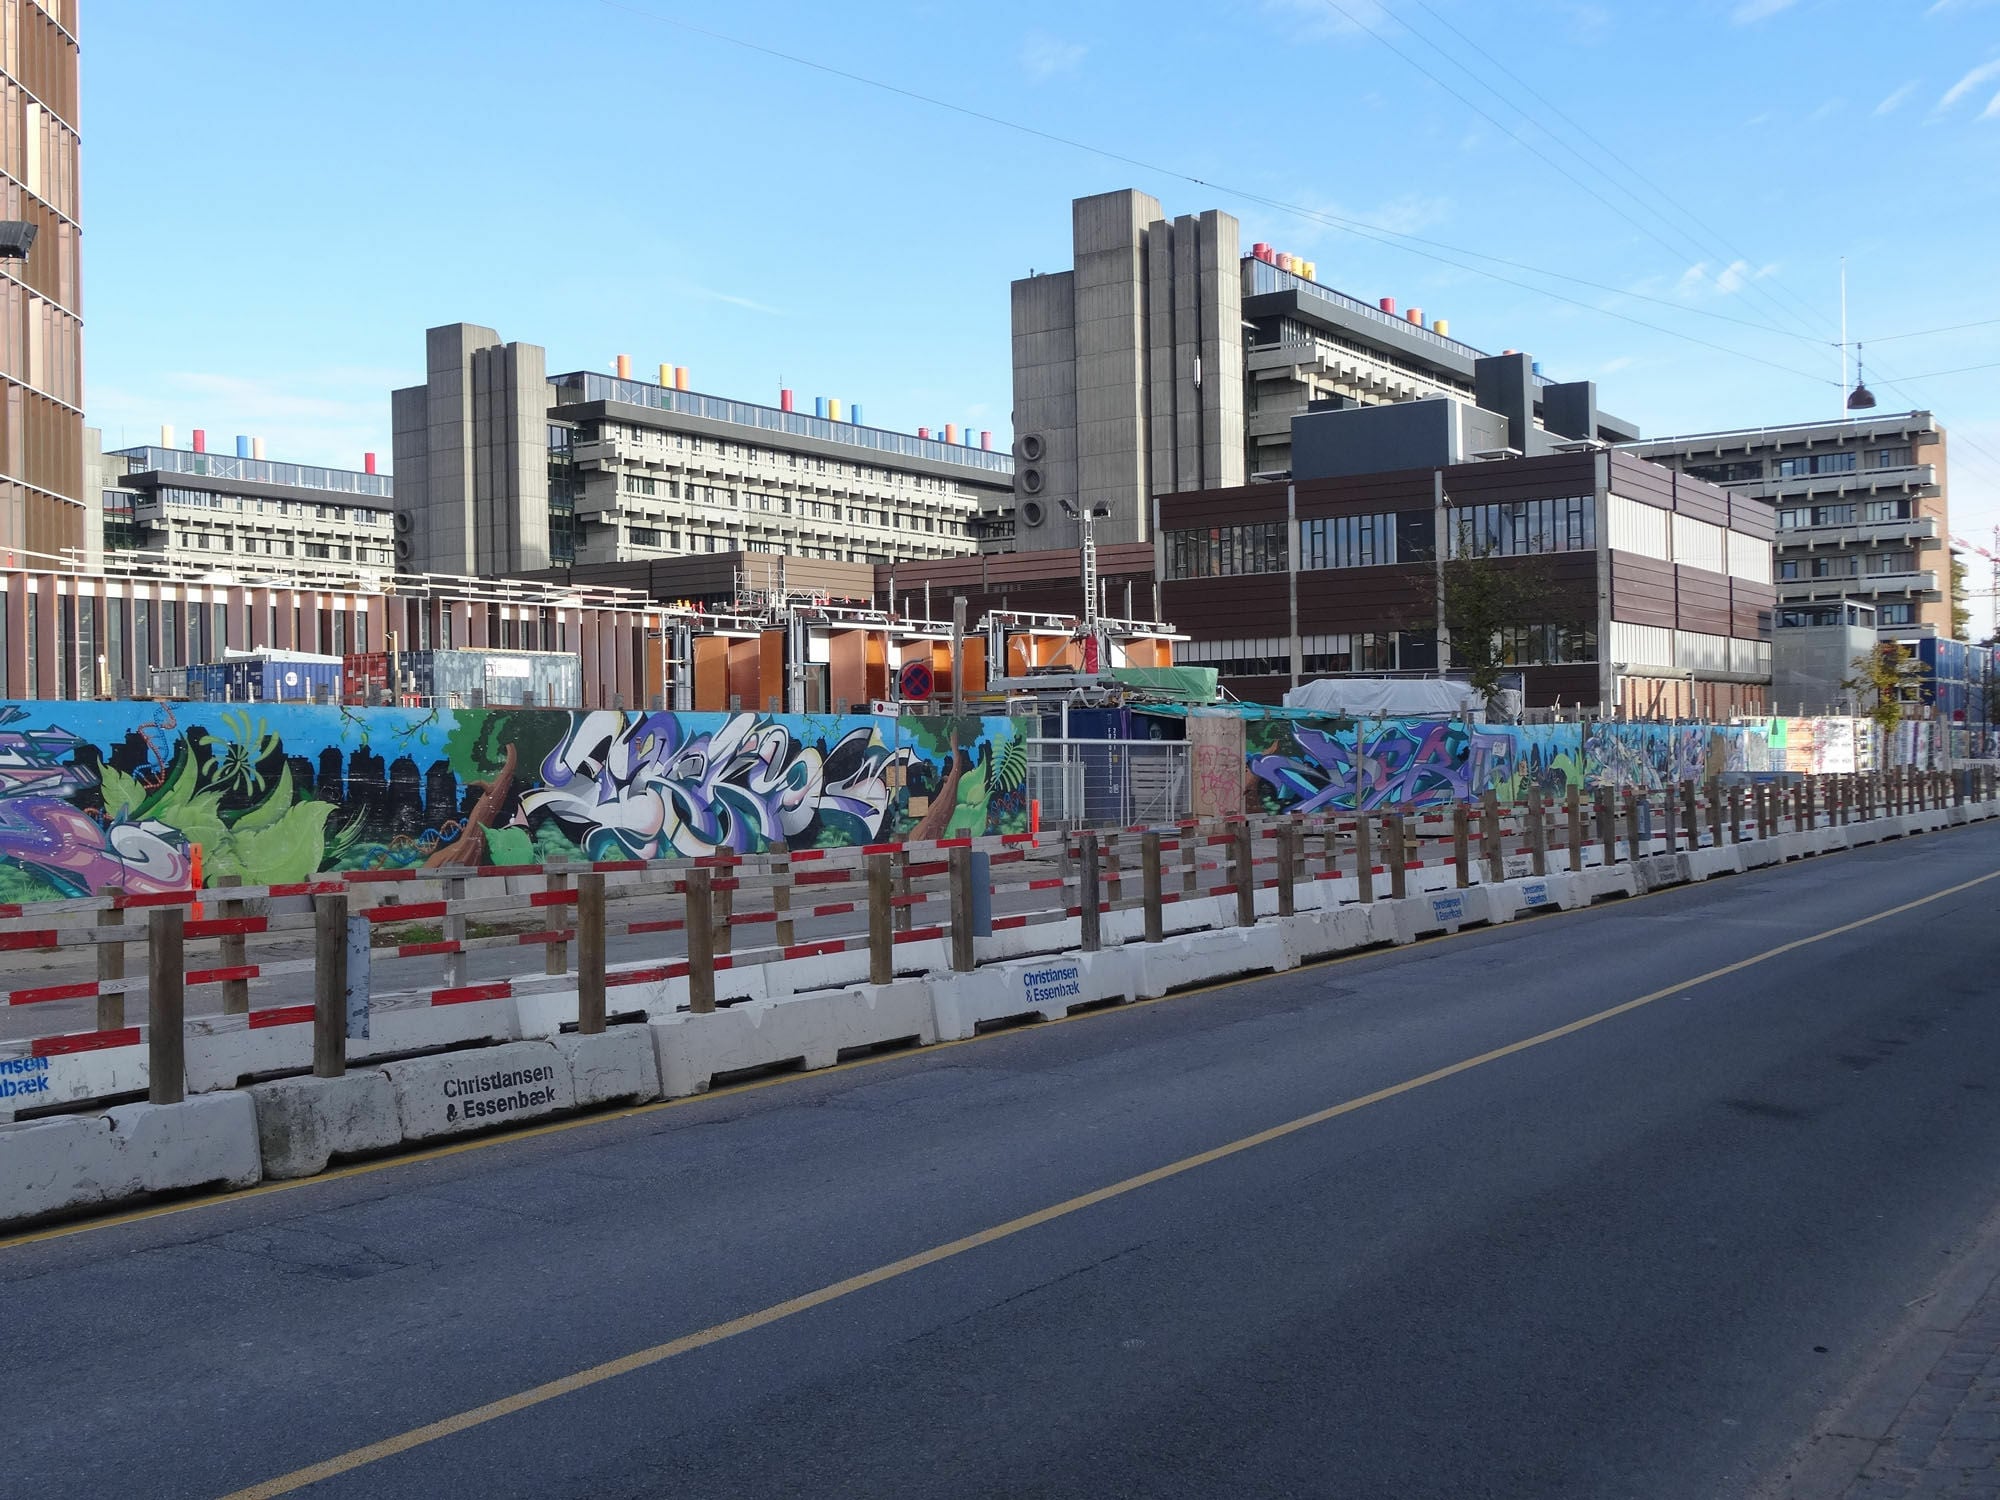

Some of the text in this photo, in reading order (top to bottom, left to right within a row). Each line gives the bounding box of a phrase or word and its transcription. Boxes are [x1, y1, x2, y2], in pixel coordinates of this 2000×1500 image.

[1023, 967, 1079, 987] Christiansen
[1033, 981, 1080, 1001] Essenbæk
[443, 1065, 554, 1098] Christiansen
[446, 1086, 556, 1122] & Essenbæk
